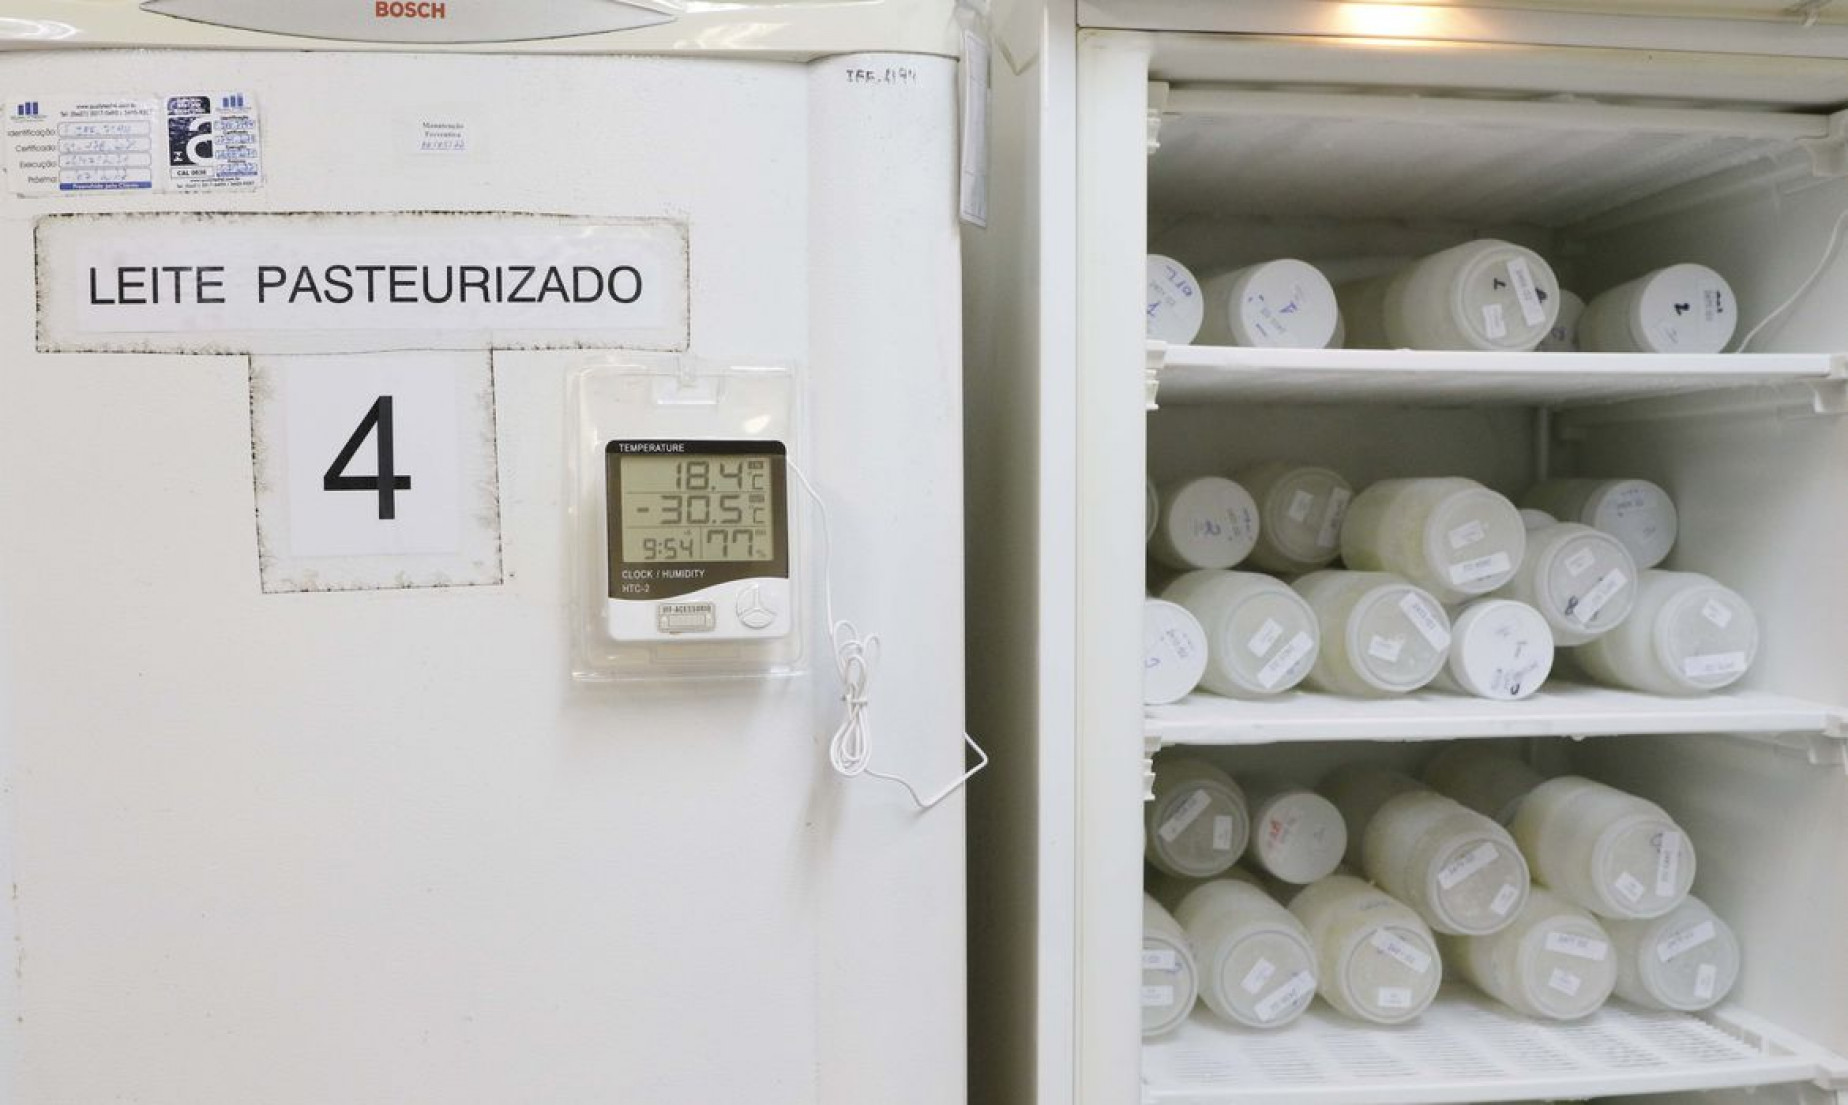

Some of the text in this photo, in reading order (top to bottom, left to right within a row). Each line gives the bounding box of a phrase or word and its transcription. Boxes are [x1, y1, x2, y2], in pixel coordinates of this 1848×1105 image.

[376, 2, 445, 19] BOSCH
[88, 265, 643, 306] LEITE PASTEURIZADO
[323, 395, 411, 520] 4
[618, 443, 685, 453] TEMPERATURE
[676, 461, 743, 491] 18.4
[637, 495, 742, 525] -30.5
[643, 538, 694, 560] 9:54
[706, 529, 754, 558] 77
[622, 570, 653, 579] CLOCK
[662, 569, 705, 579] HUMIDITY
[622, 585, 650, 593] HTC-2
